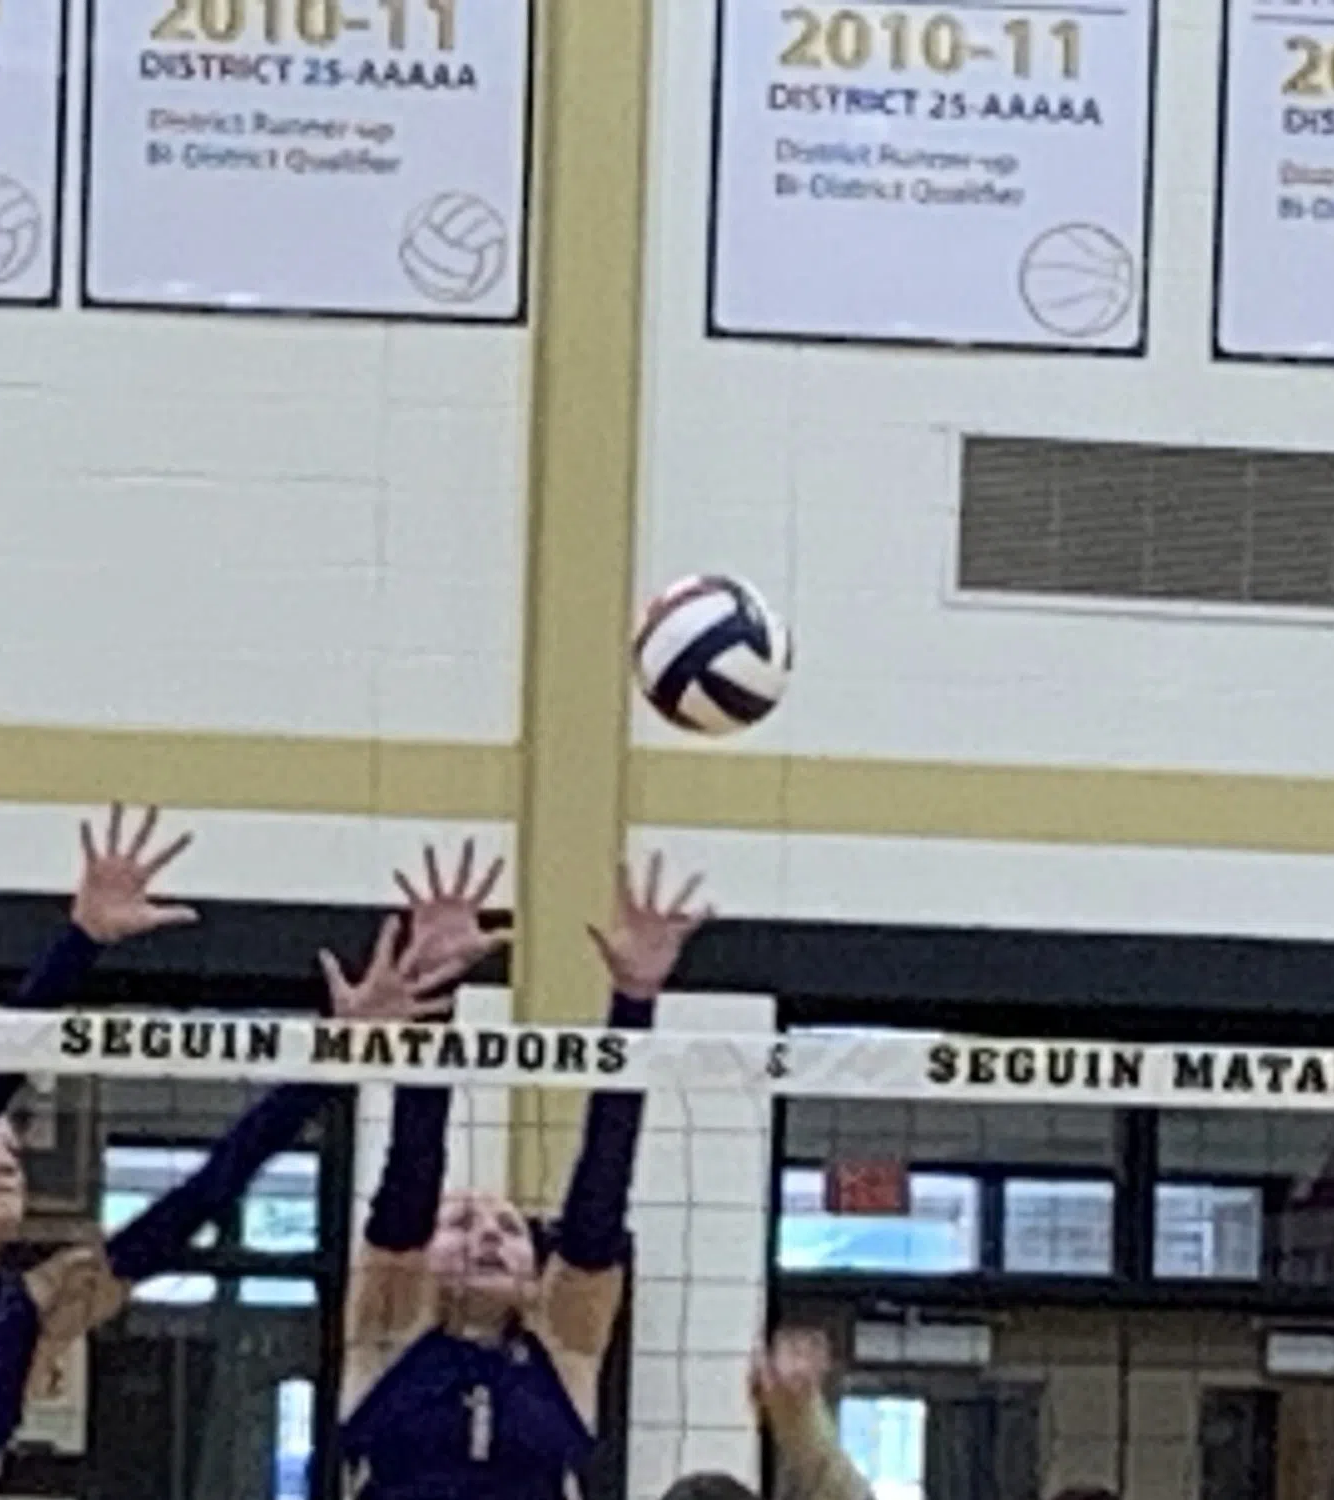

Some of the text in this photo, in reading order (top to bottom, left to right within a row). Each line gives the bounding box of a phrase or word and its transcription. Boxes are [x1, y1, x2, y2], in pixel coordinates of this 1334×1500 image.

[150, 0, 455, 51] 2010-11
[779, 7, 1081, 79] 2010-11
[140, 50, 478, 91] DISTRICT 25-AAAAA
[768, 83, 1102, 125] DISTRICT 25-AAAAA
[61, 1017, 630, 1073] SEGUIN MATADORS
[926, 1044, 1143, 1089] SEGUIN
[462, 1384, 492, 1461] 1
